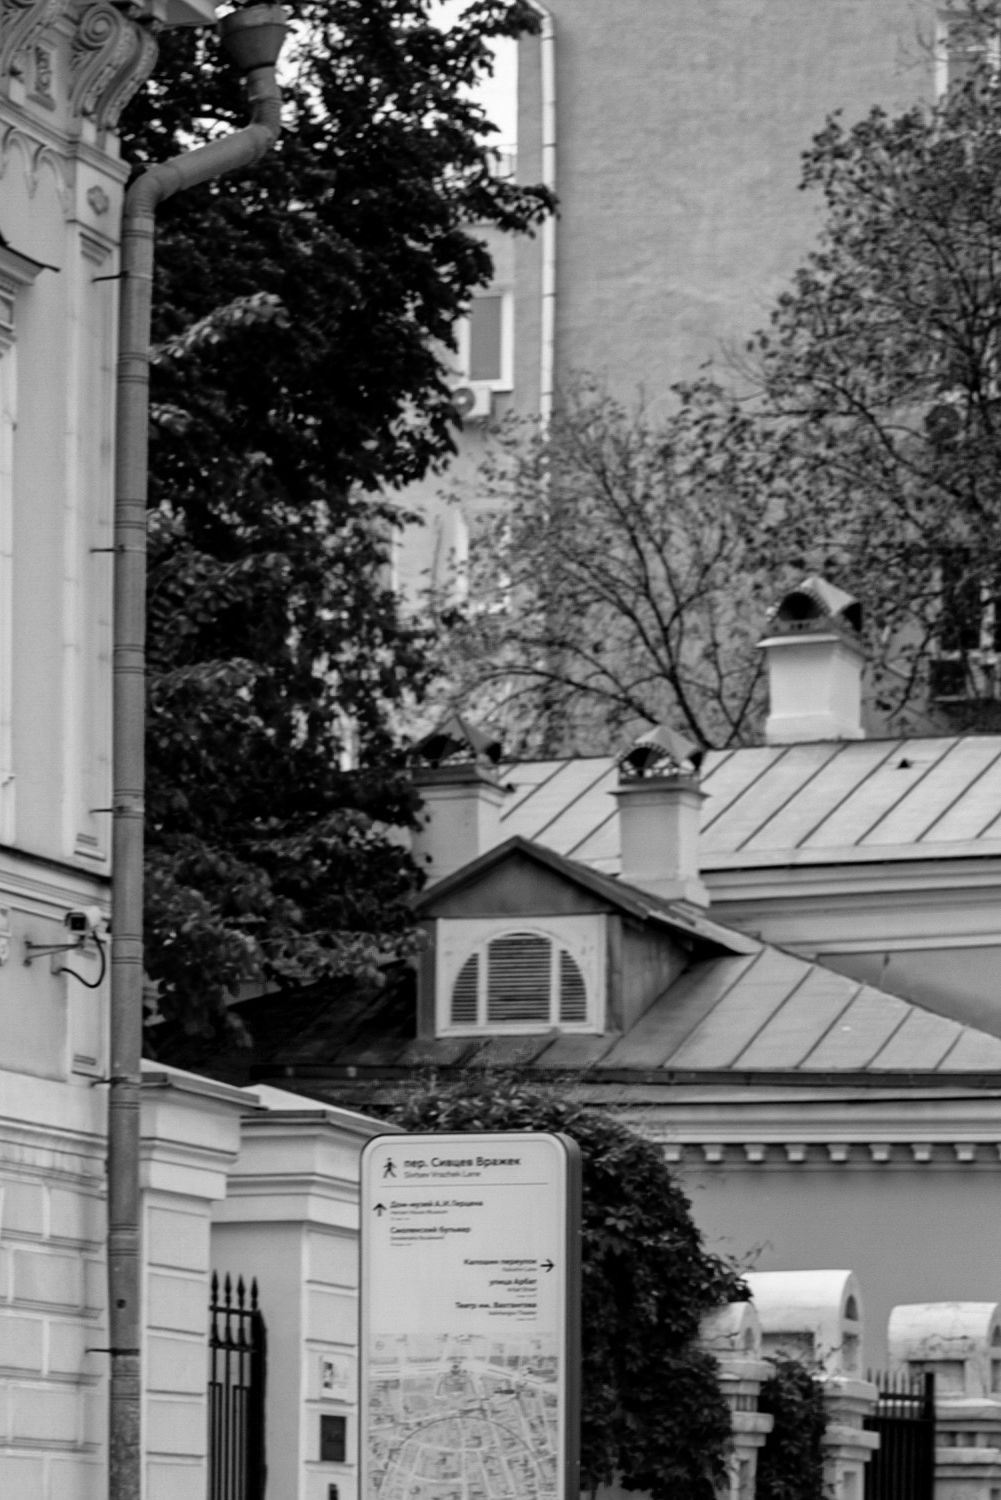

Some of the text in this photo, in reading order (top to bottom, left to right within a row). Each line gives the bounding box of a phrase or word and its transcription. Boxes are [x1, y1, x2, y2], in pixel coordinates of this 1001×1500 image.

[403, 1156, 521, 1170] пер. Сивцев Вражек
